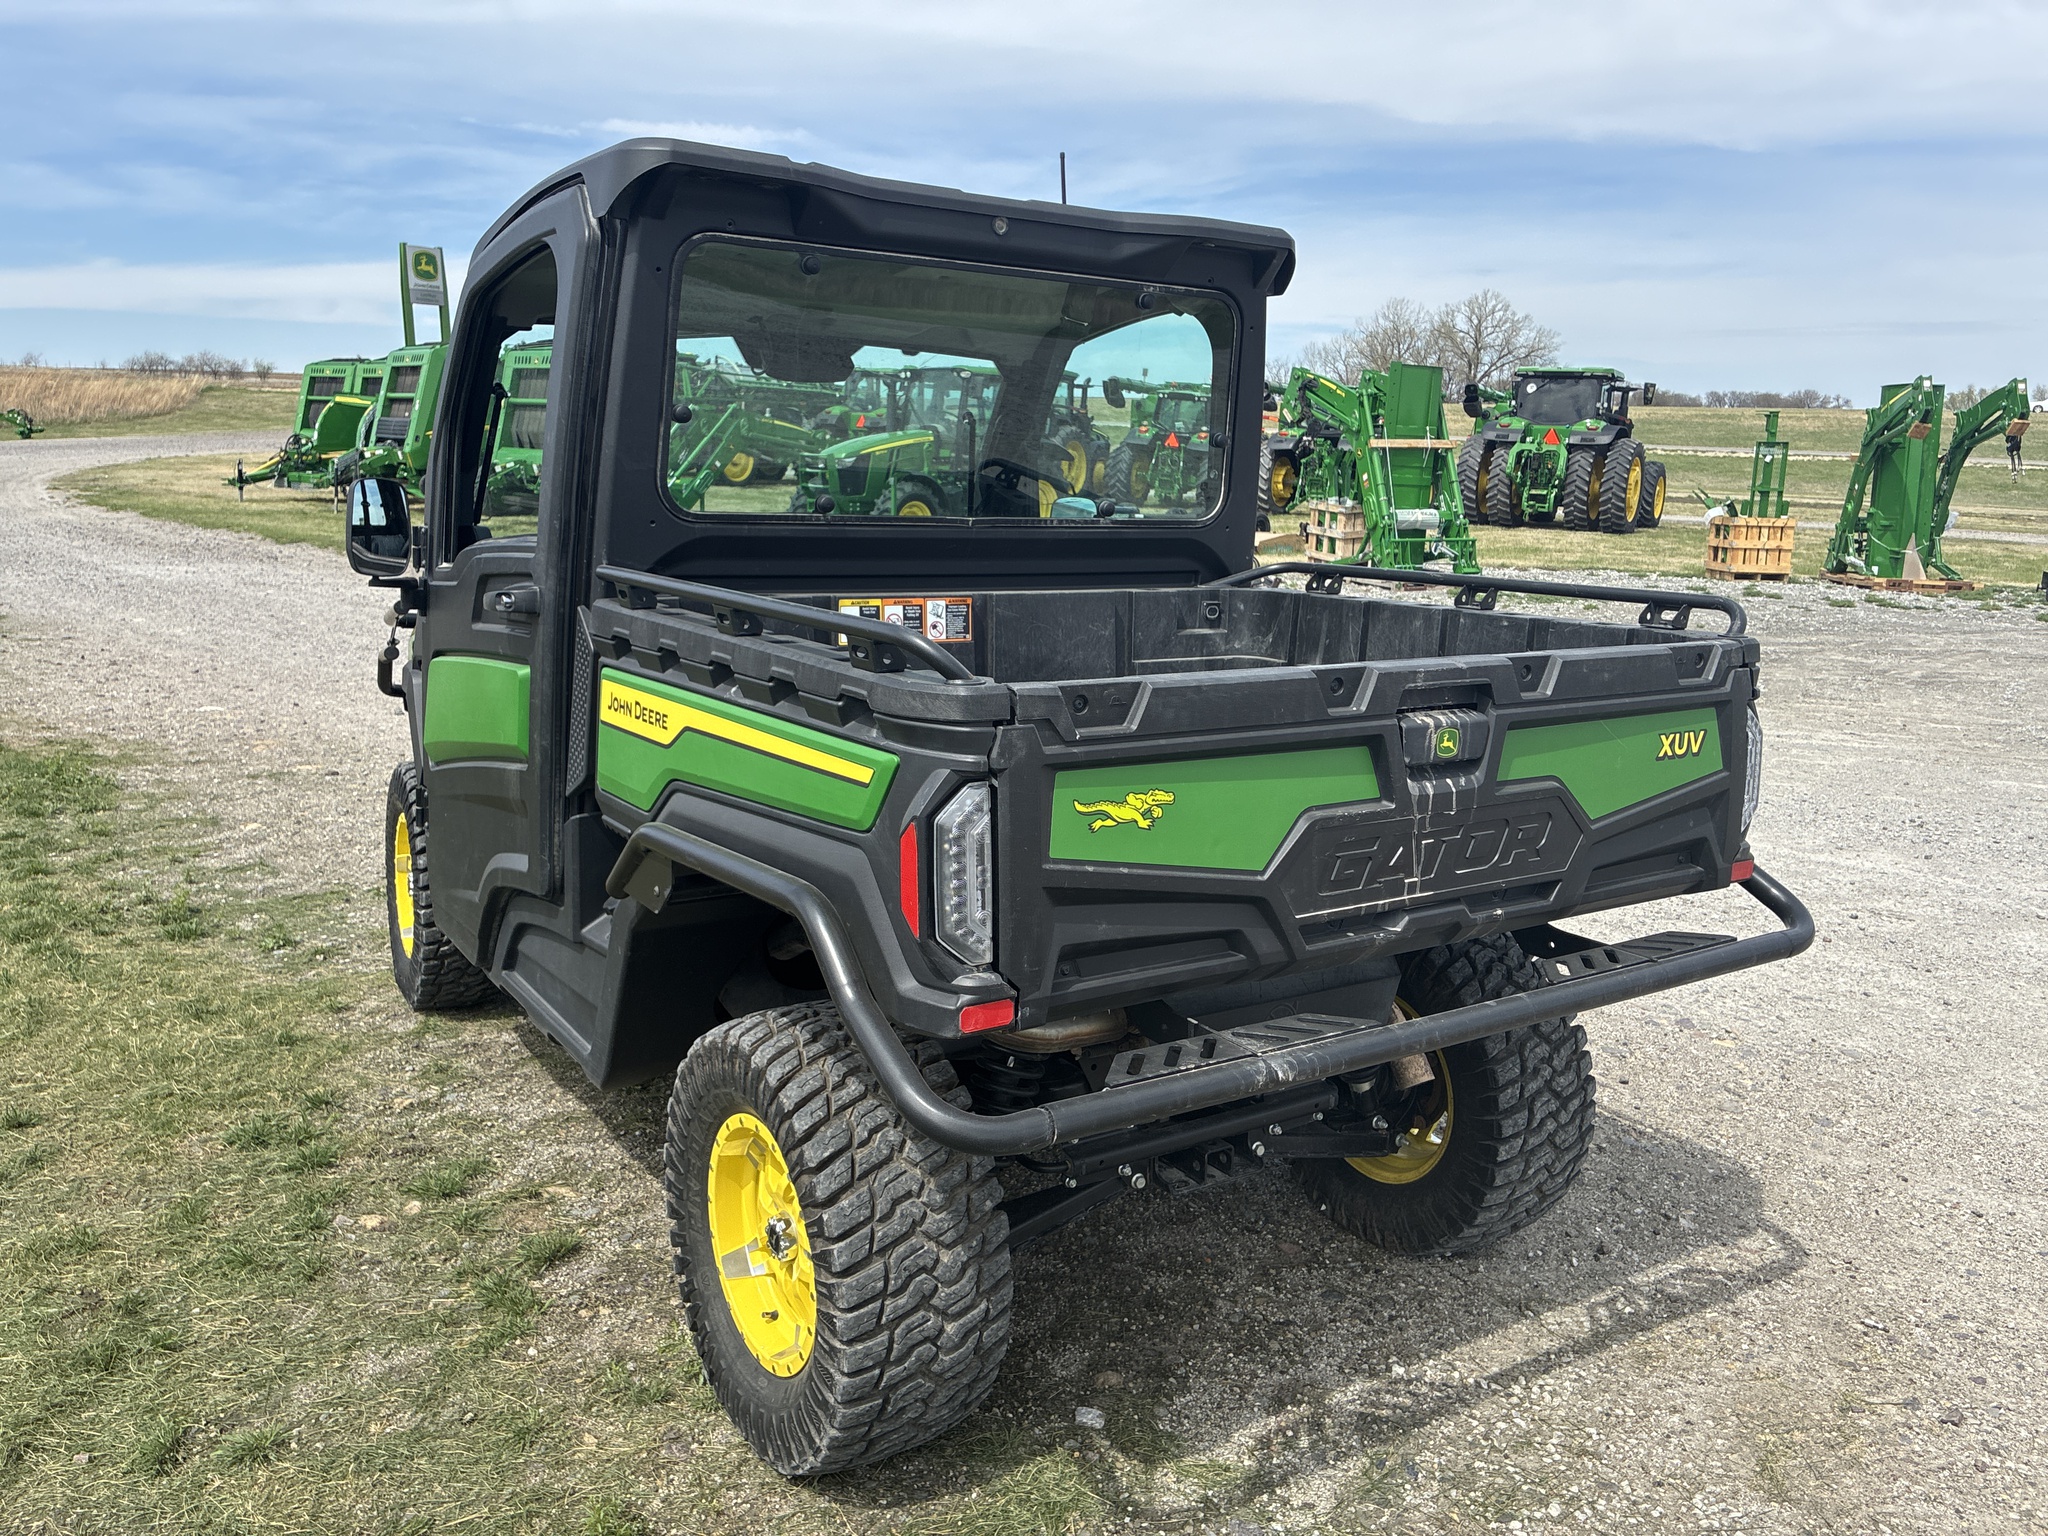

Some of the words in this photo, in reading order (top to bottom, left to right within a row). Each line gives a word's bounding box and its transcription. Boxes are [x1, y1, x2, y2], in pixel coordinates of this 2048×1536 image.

[607, 691, 633, 718] JOHN
[634, 700, 669, 730] DEERE
[1655, 729, 1707, 761] XUV
[1317, 811, 1553, 896] GATOR
